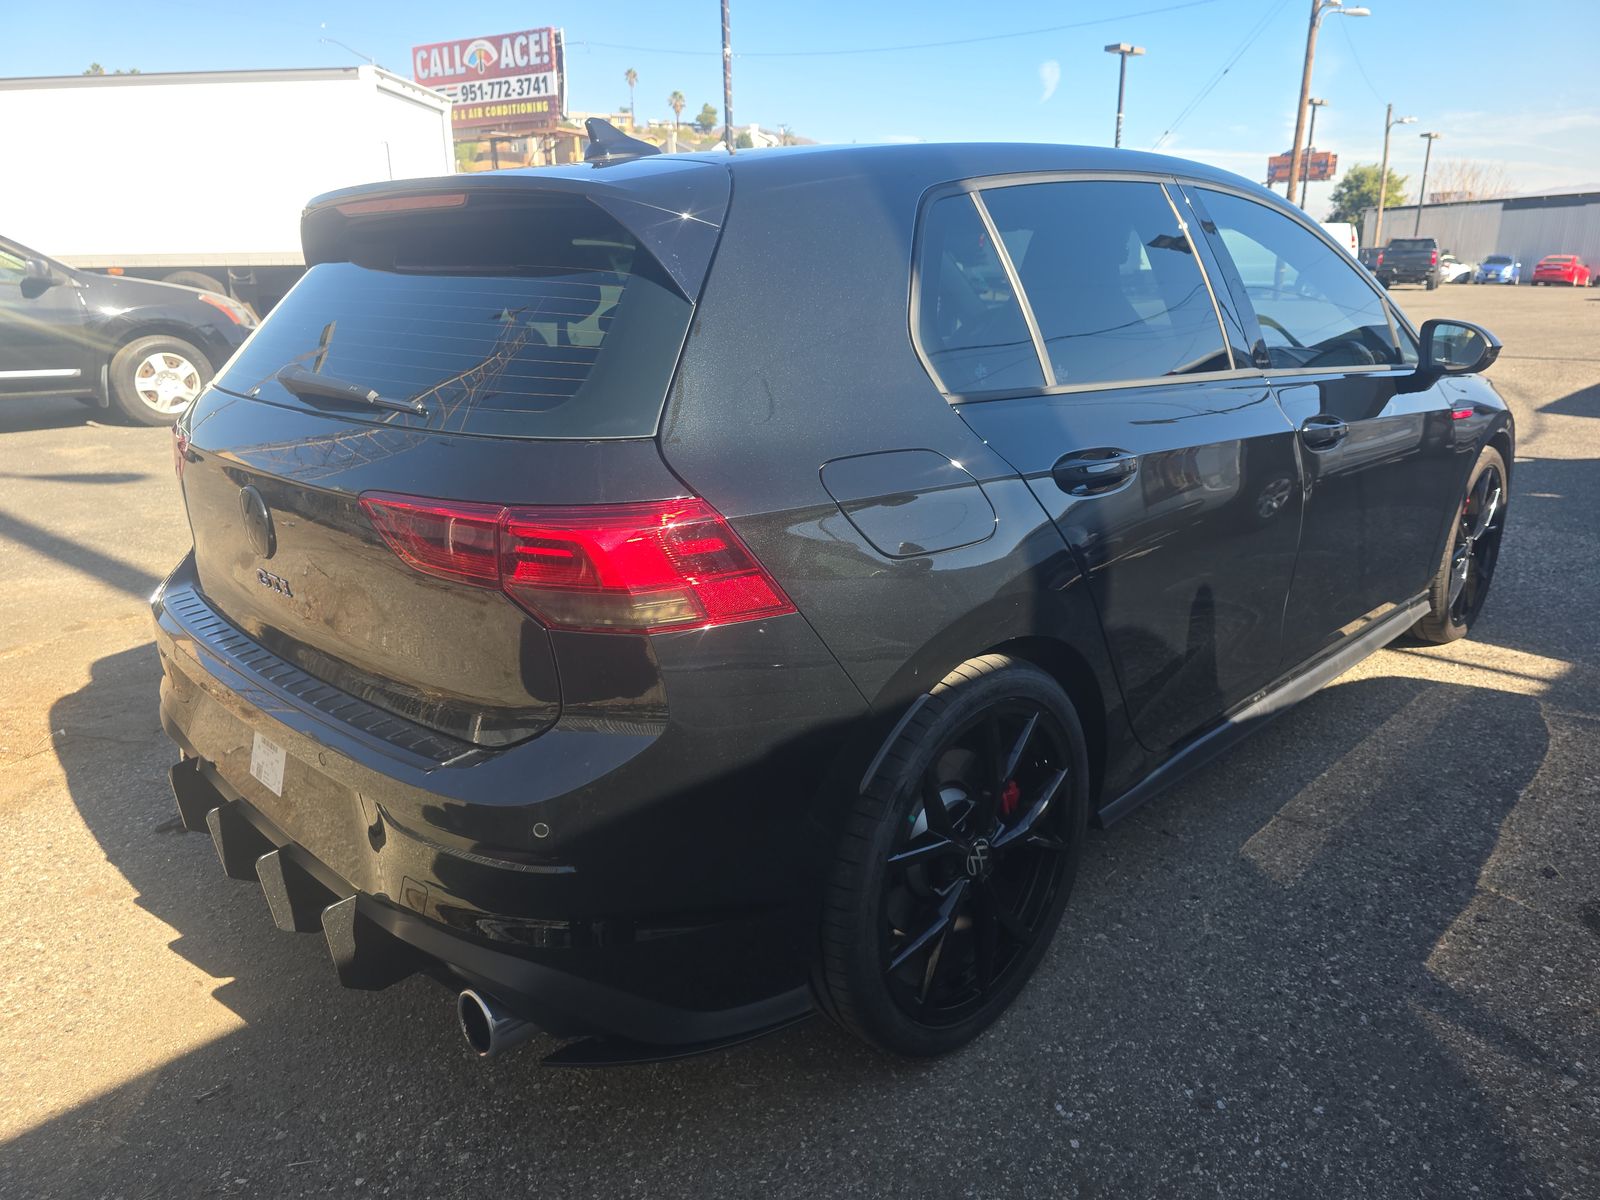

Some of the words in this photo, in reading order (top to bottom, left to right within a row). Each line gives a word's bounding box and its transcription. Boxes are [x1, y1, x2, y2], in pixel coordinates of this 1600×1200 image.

[416, 45, 466, 79] CALL
[500, 31, 550, 69] ACE!
[468, 107, 483, 119] AIR
[485, 101, 549, 117] CONDITIONING
[256, 567, 293, 598] GTI
